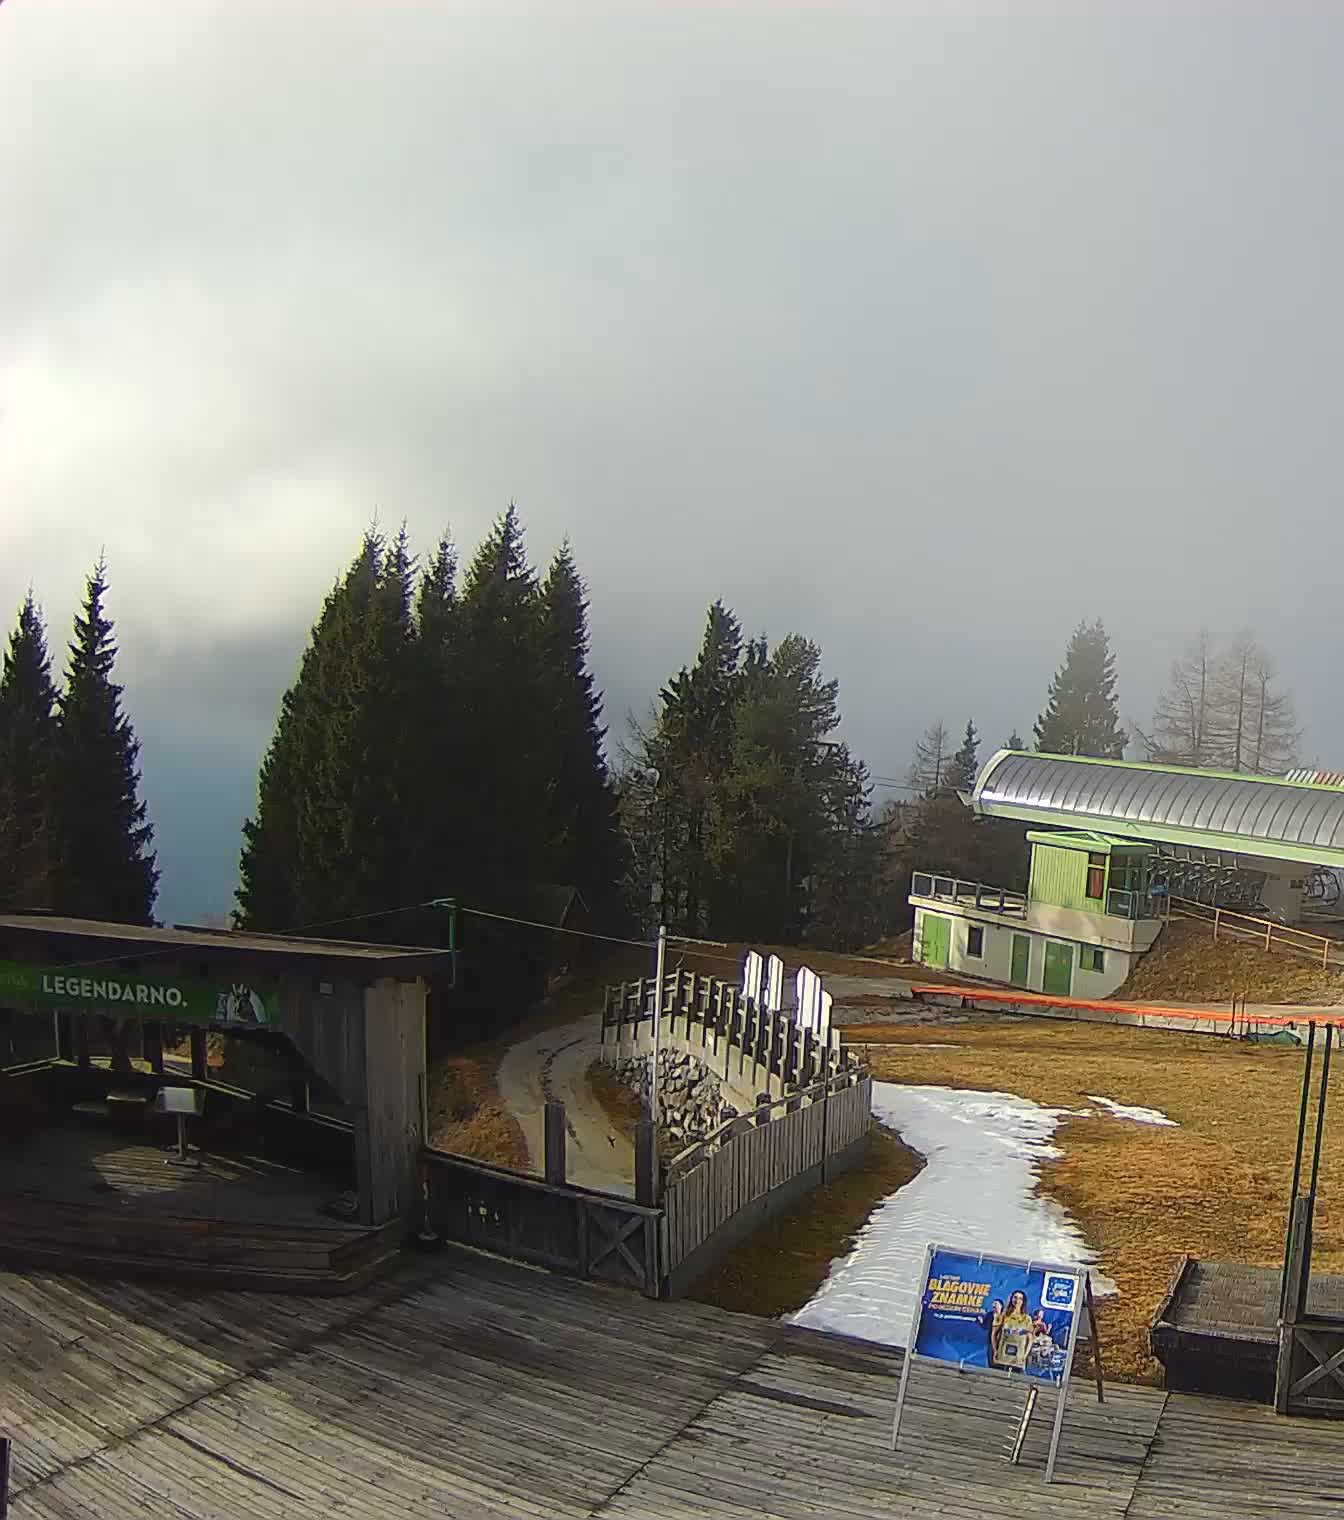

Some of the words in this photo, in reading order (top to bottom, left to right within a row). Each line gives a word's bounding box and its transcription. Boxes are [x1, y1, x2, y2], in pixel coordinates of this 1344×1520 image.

[42, 974, 188, 1008] LEGENDARNO.
[928, 1278, 991, 1296] BLAGOVNE
[931, 1291, 984, 1307] ZNAMKE
